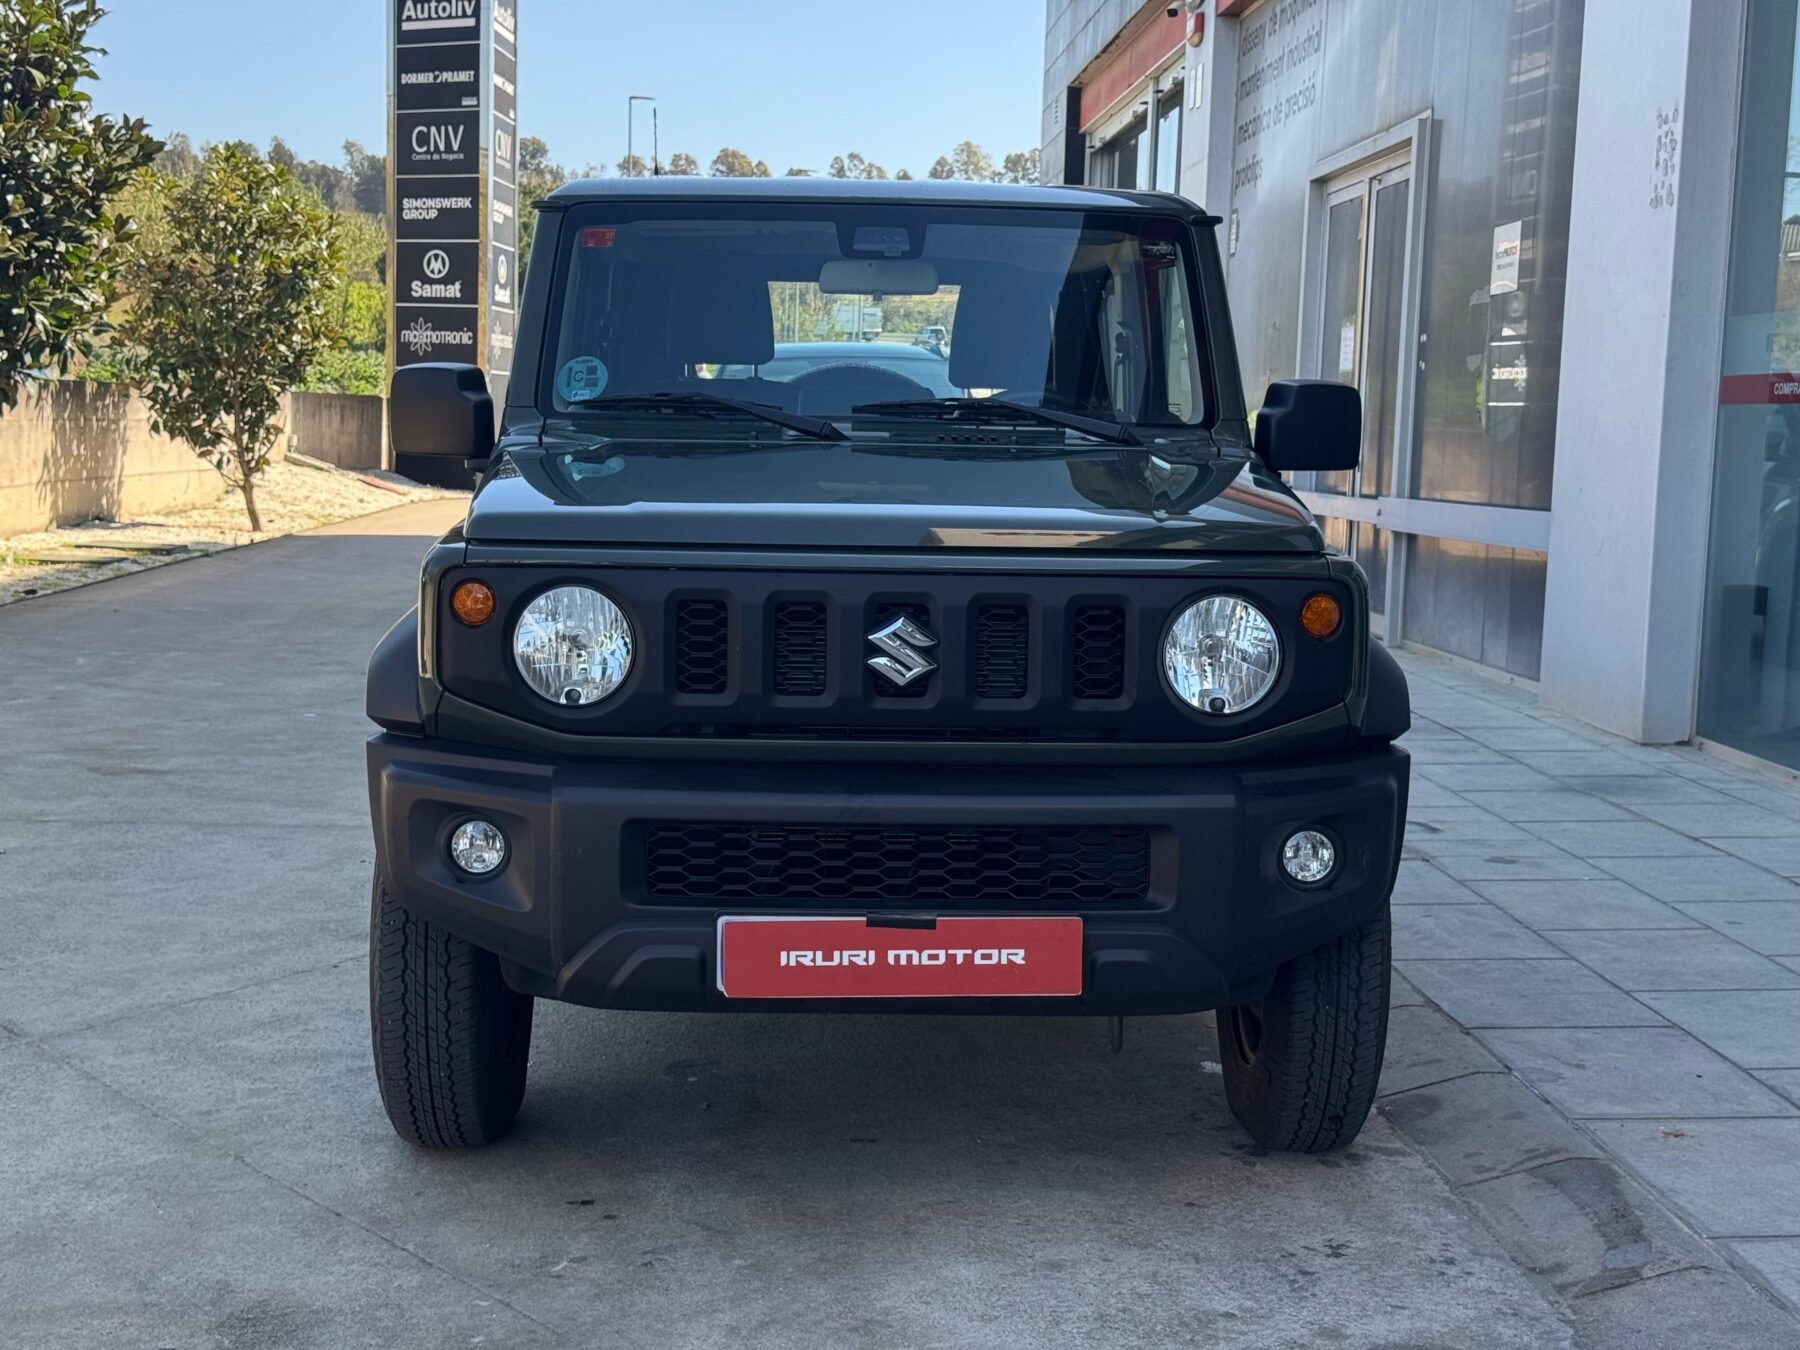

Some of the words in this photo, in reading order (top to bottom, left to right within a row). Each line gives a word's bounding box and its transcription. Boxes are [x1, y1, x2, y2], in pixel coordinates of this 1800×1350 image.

[401, 0, 476, 20] Autoliv
[401, 72, 434, 85] DORMER
[442, 70, 475, 83] PRAMET
[412, 125, 464, 152] CNV
[402, 197, 472, 209] SIMONSWERK
[402, 209, 438, 220] GROUP
[411, 280, 462, 298] Samat
[1774, 382, 1800, 395] COMPR
[780, 950, 875, 966] IRURI
[887, 948, 1026, 966] MOTOR
